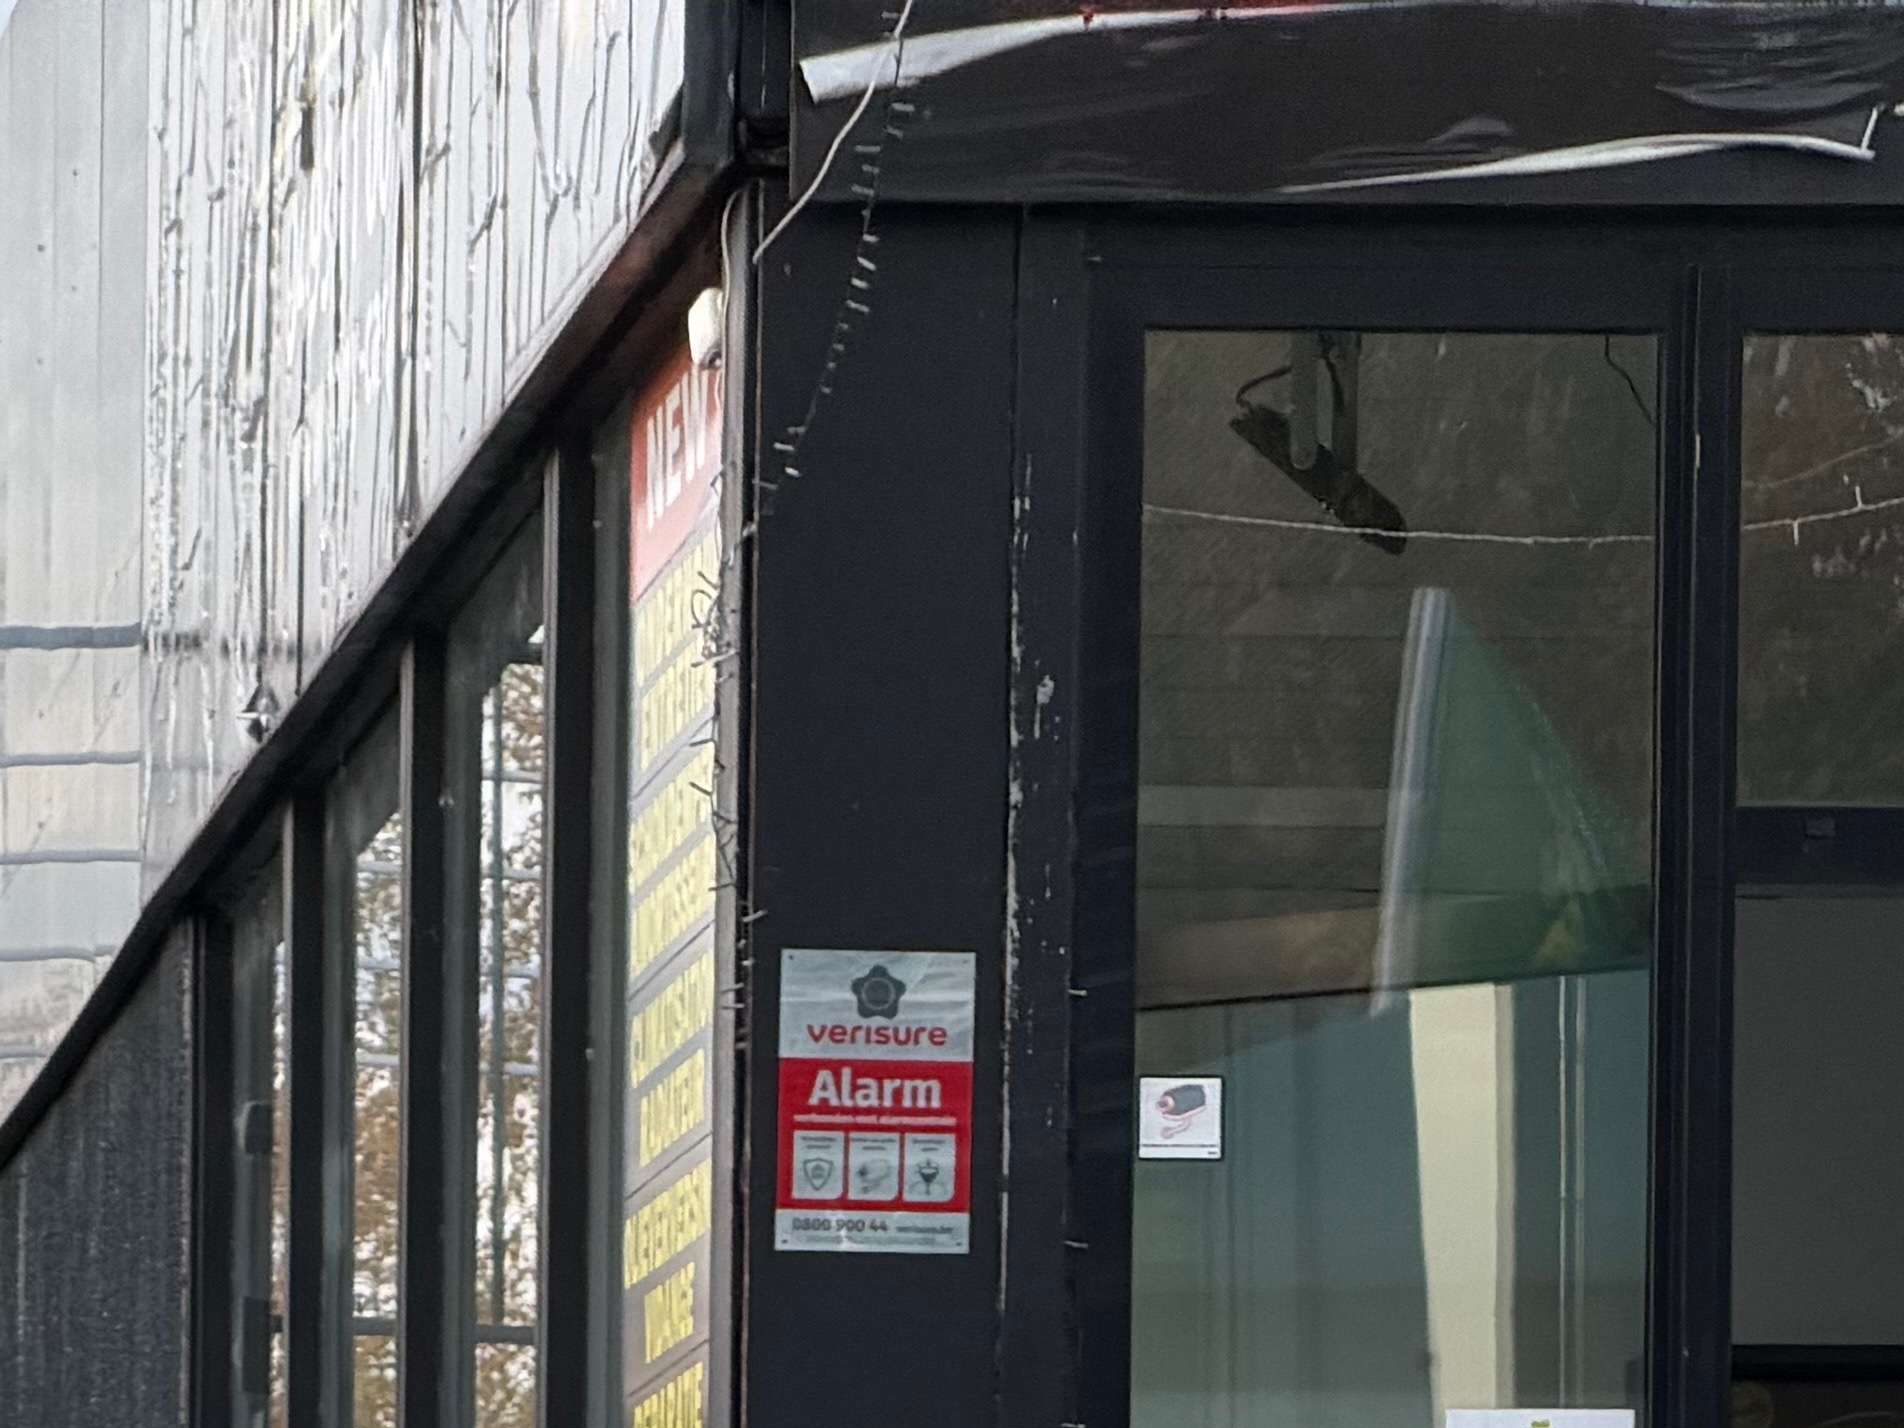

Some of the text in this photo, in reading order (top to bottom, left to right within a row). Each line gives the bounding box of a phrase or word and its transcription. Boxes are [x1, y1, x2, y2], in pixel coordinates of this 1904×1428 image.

[645, 366, 708, 531] NEW
[806, 1023, 948, 1047] verisure
[808, 1066, 942, 1109] Alarm
[834, 1218, 866, 1233] 900
